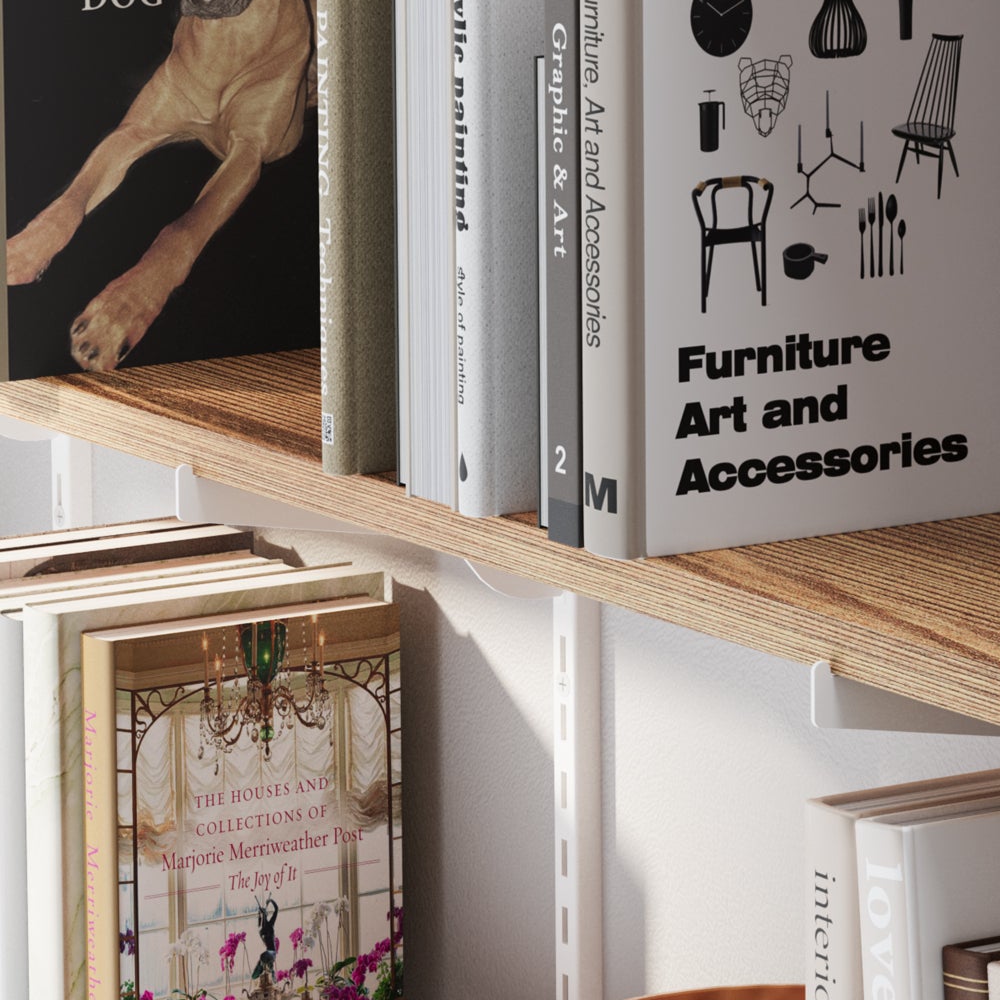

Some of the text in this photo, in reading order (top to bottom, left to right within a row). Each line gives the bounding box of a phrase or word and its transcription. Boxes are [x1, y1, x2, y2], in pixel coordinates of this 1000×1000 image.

[316, 11, 330, 197] PAINTING
[584, 96, 606, 135] Art
[548, 22, 569, 259] Graphic & Art
[584, 139, 606, 191] and
[584, 194, 607, 349] Accessories
[457, 312, 467, 332] of
[677, 331, 892, 384] Furniture
[675, 383, 849, 440] Art and
[554, 445, 567, 475] 2
[675, 432, 969, 496] Accessories
[584, 471, 618, 515] M
[84, 710, 99, 822] Marjorie
[194, 775, 330, 809] THE HOUSES AND
[195, 804, 328, 837] COLLECTIONS OF
[161, 826, 364, 875] Marjorie Merriweather Post
[228, 863, 298, 893] The Joy of It
